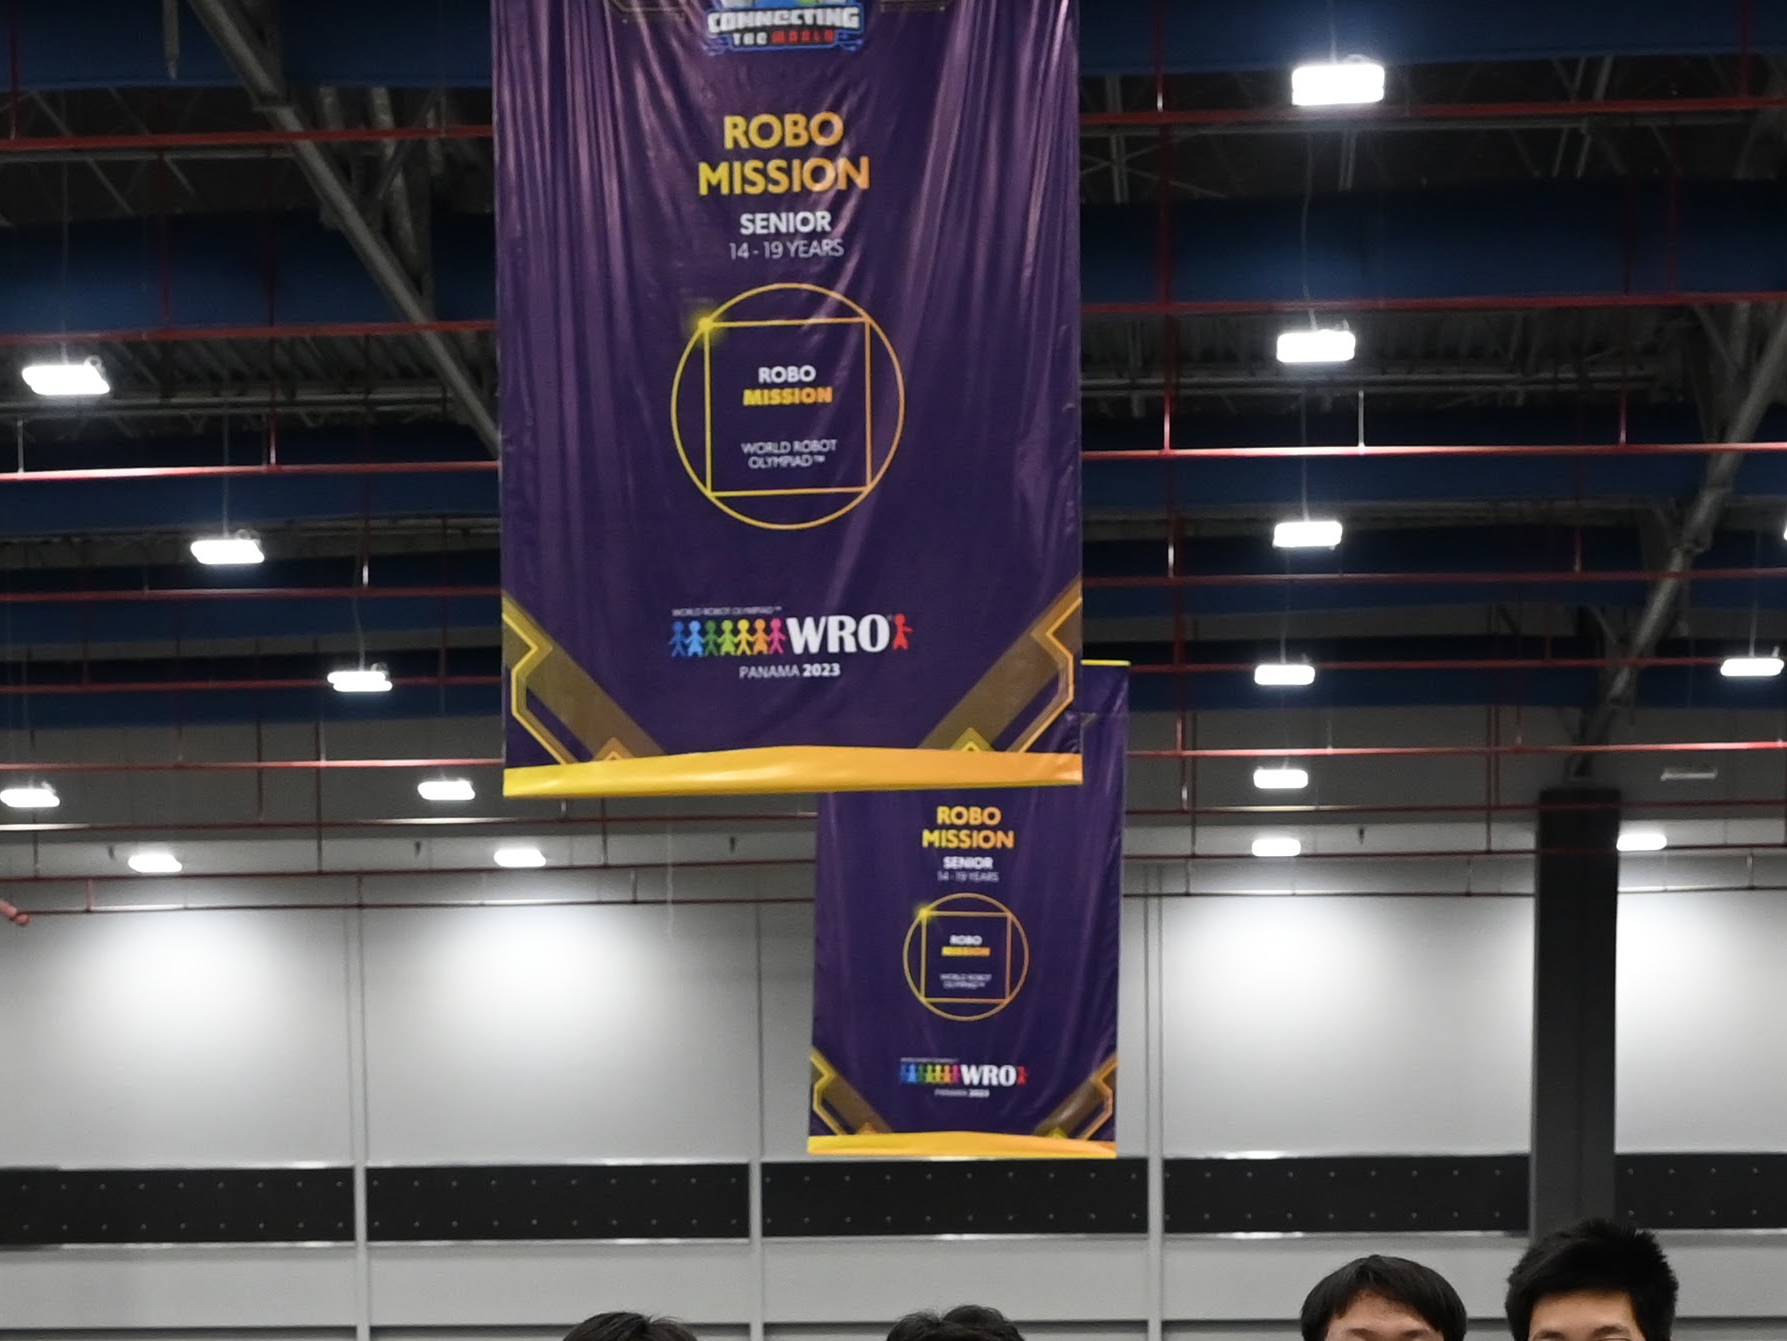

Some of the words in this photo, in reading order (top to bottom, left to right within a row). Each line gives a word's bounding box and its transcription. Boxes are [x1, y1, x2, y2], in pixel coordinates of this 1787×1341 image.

[724, 111, 845, 150] ROBO
[698, 155, 871, 196] MISSION
[739, 210, 833, 236] SENIOR
[729, 242, 750, 260] 14
[763, 240, 784, 259] 19
[786, 238, 845, 258] YEARS
[758, 364, 817, 384] ROBO
[742, 386, 833, 406] MISSION
[740, 441, 792, 455] WORLD
[793, 439, 837, 453] ROBOT
[786, 613, 891, 655] WRO
[739, 664, 799, 680] PANAMA
[802, 662, 841, 678] 2023
[936, 805, 1002, 827] ROBO
[922, 828, 1015, 850] MISSION
[943, 856, 994, 870] SENIOR
[960, 1064, 1017, 1087] WRO
